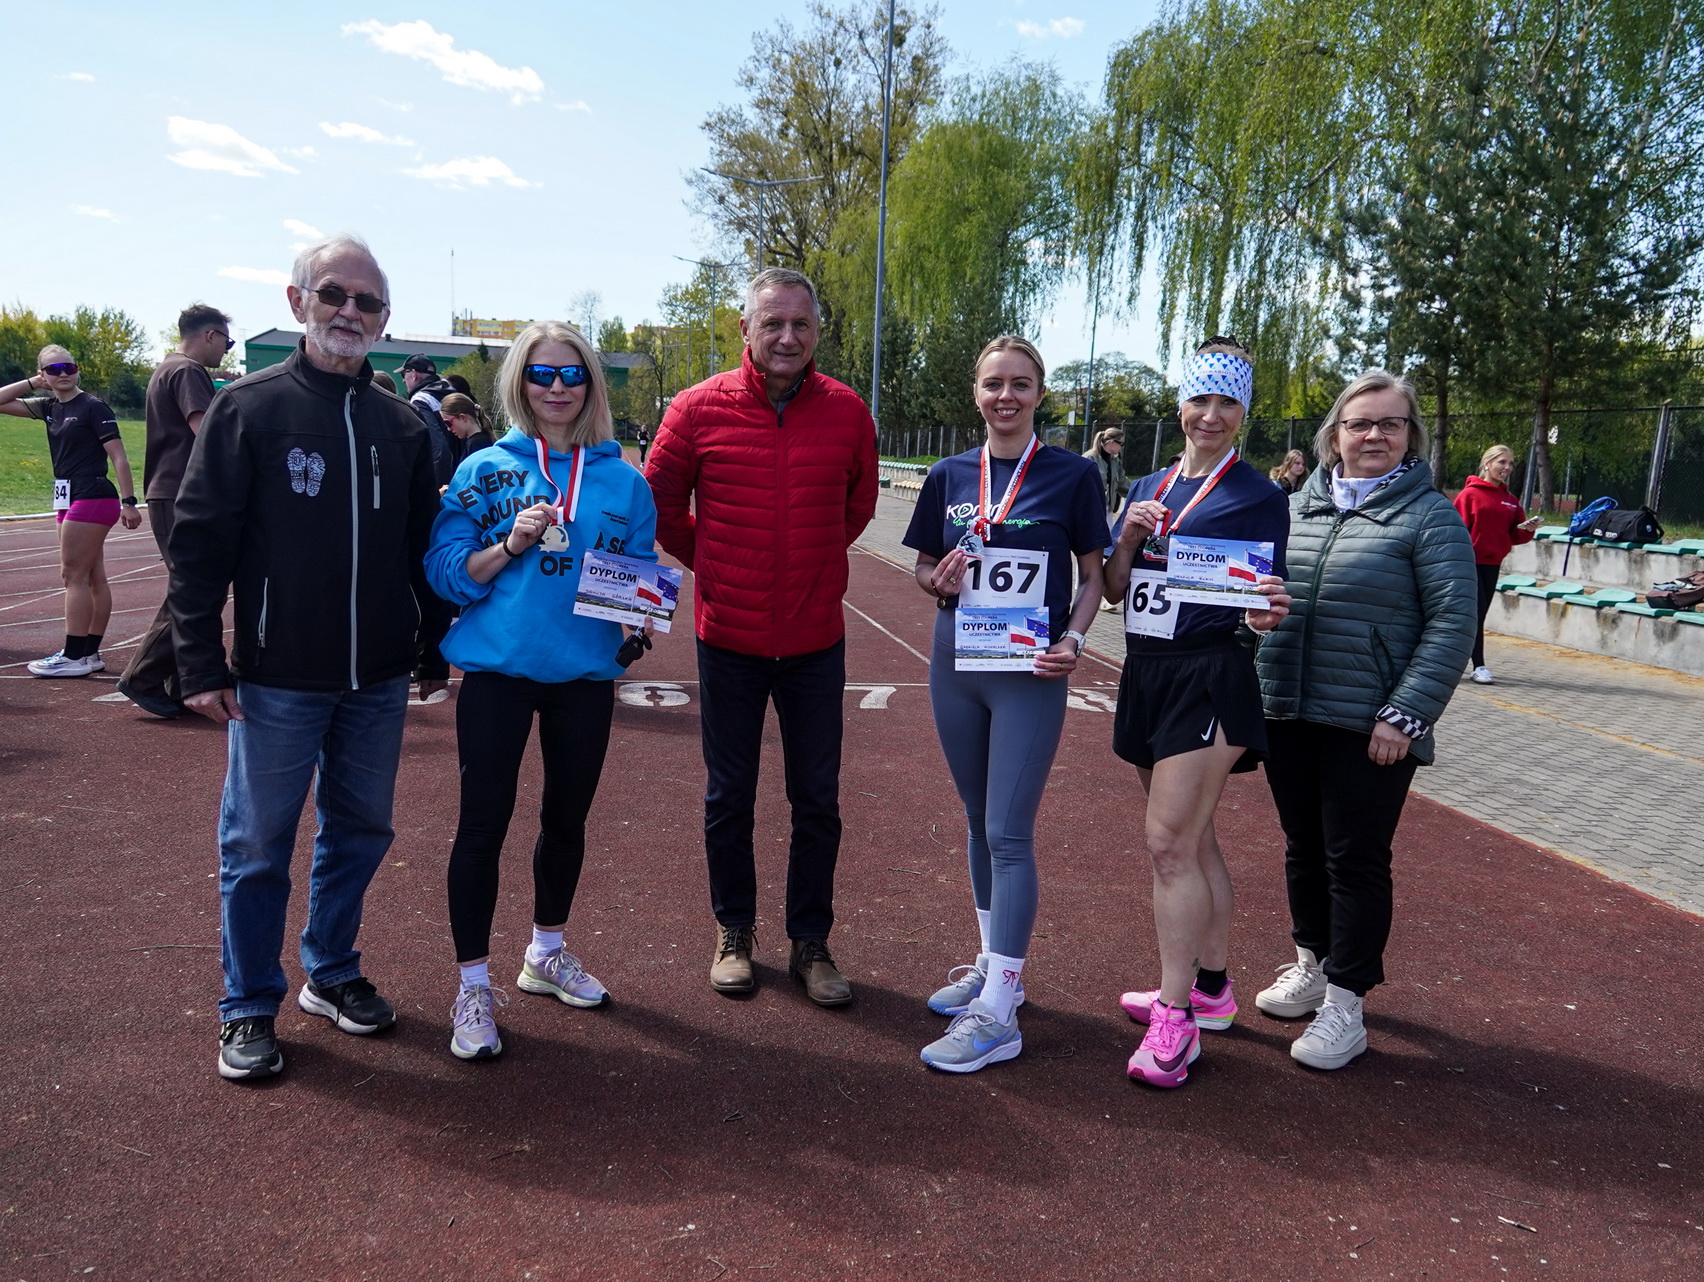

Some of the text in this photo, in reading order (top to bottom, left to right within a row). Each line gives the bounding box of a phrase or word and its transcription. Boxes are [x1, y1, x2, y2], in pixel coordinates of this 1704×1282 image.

[457, 470, 529, 509] EVERY
[1002, 519, 1036, 529] nergia
[540, 555, 573, 576] OF
[1176, 551, 1226, 563] DYPLOM
[589, 566, 637, 583] DYPLOM
[967, 559, 1040, 594] 167
[962, 622, 1007, 631] DYPLOM
[619, 682, 691, 707] 6
[844, 686, 897, 709] 7
